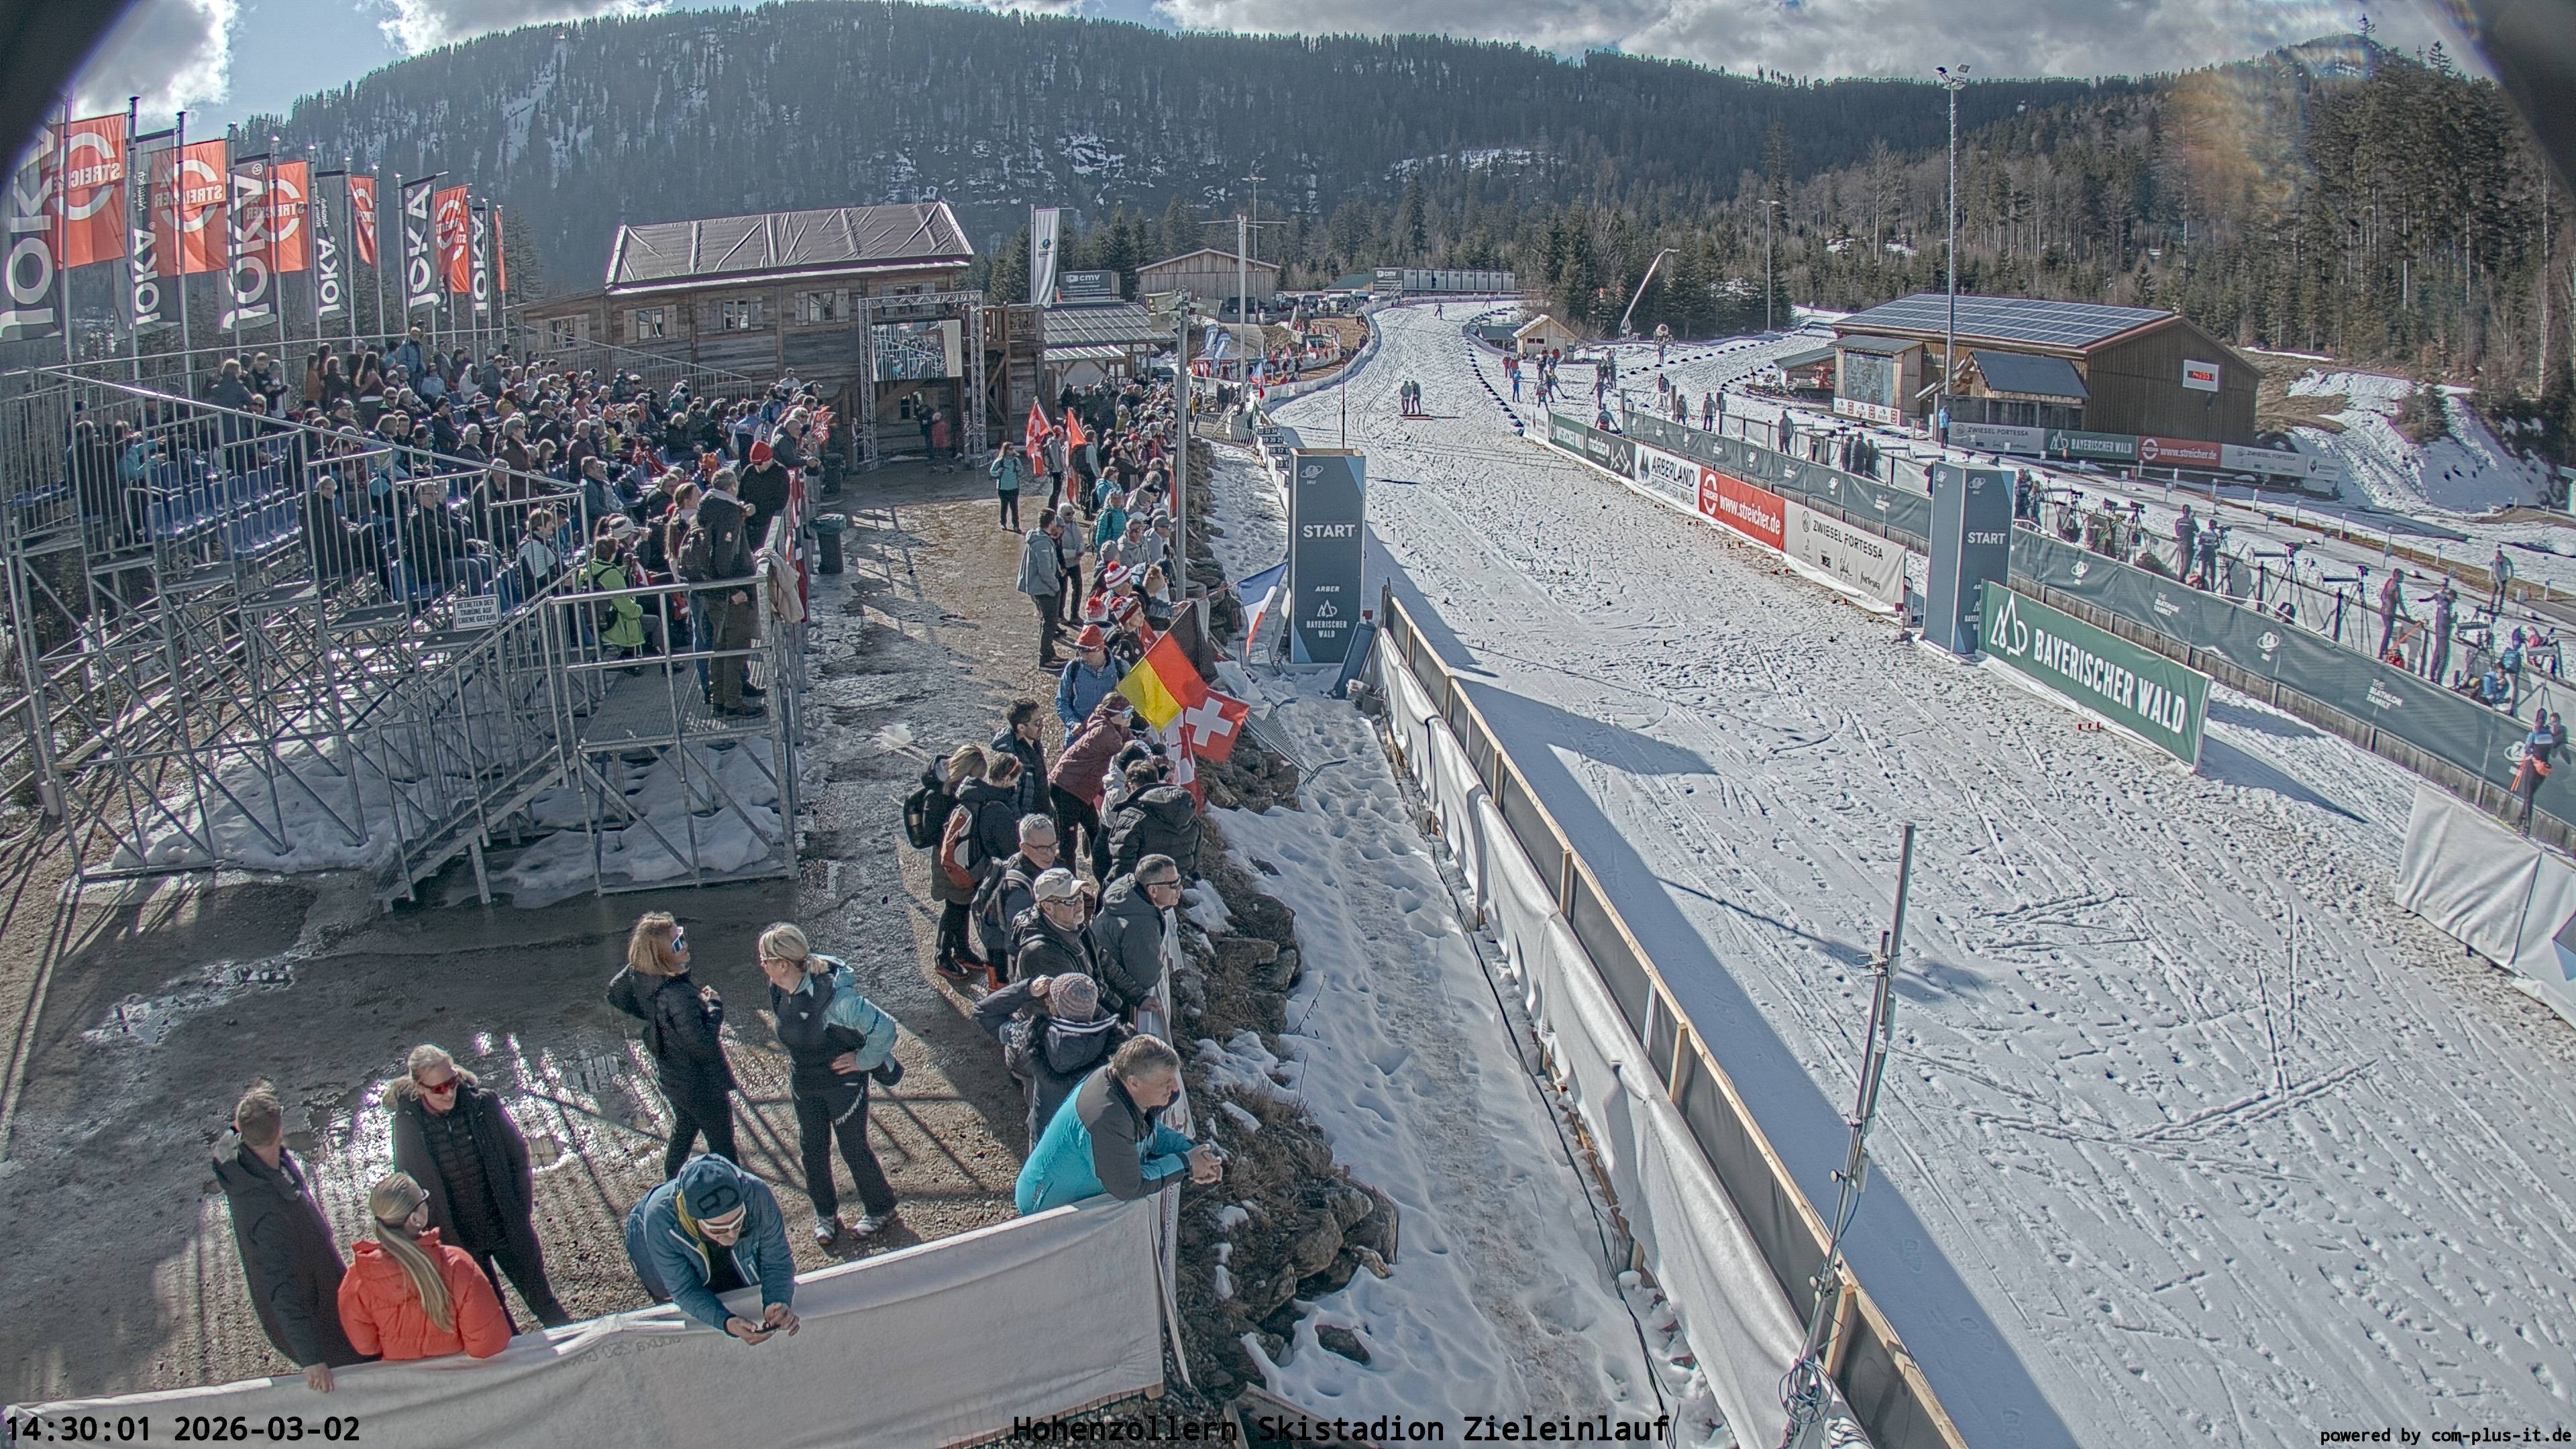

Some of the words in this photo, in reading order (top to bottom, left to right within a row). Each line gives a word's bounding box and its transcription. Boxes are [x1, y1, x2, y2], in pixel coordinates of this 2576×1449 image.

[407, 184, 441, 309] JOKA
[2071, 439, 2114, 453] BAYERISCHER
[2115, 441, 2133, 454] WALD
[2160, 447, 2217, 460] www.streicher.de
[1651, 455, 1695, 488] ARBERLAND
[1719, 494, 1780, 535] www.streicher.de
[1302, 524, 1356, 538] START
[1967, 531, 2006, 545] START
[1813, 519, 1843, 543] ZWIESEL
[1844, 533, 1884, 561] FORTESSA
[1306, 620, 1348, 629] BAYERISCHER
[1318, 629, 1336, 638] WALD
[2033, 628, 2135, 709] BAYERISCHER
[2137, 677, 2186, 735] WALD
[2372, 678, 2385, 690] THE
[2365, 693, 2392, 710] FAMILY
[2369, 686, 2404, 707] BIATHLON
